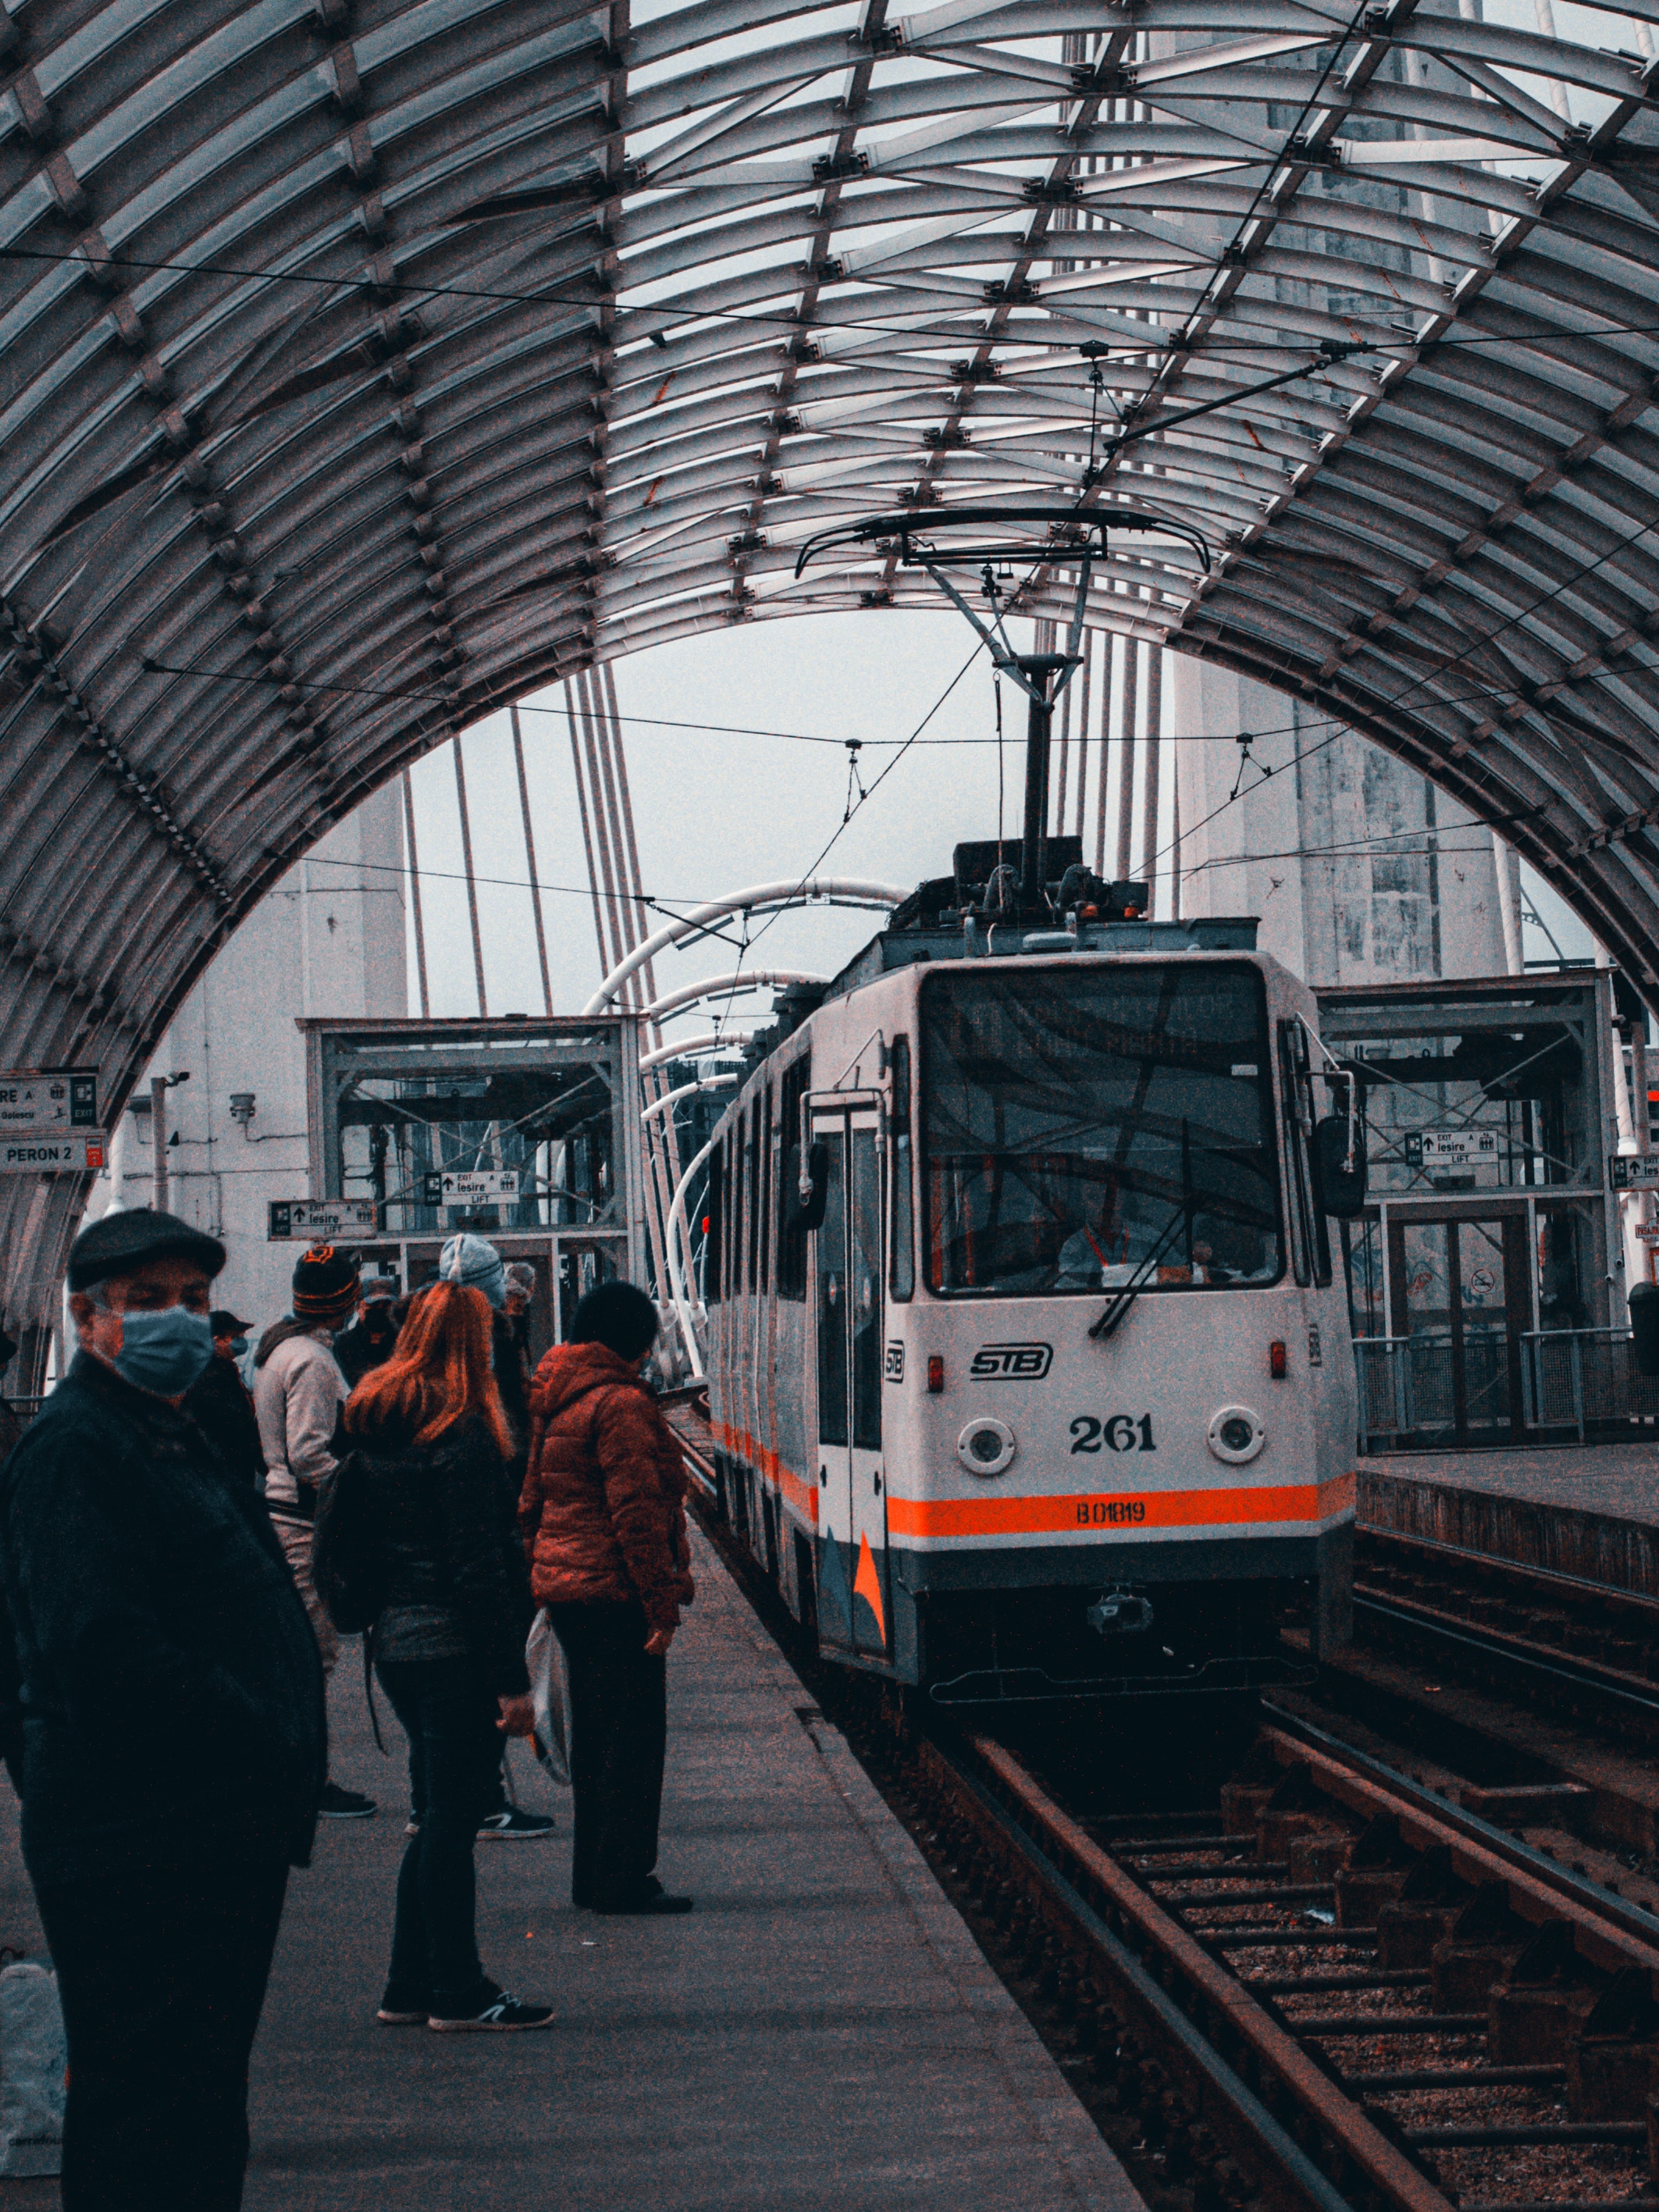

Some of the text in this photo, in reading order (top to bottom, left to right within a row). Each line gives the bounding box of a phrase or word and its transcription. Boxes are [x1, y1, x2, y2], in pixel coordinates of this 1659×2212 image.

[25, 1092, 33, 1100] A
[2, 1111, 34, 1120] Golescu
[75, 1109, 93, 1118] EXIT
[1437, 1142, 1465, 1152] Iesire
[7, 1148, 59, 1162] PERON
[63, 1147, 72, 1159] 2
[457, 1183, 486, 1192] Iesire
[472, 1195, 490, 1204] LIFT
[309, 1213, 340, 1224] Iesire
[324, 1225, 342, 1234] LIFT
[885, 1348, 902, 1375] STB
[970, 1350, 1045, 1373] STB
[1070, 1413, 1157, 1455] 261
